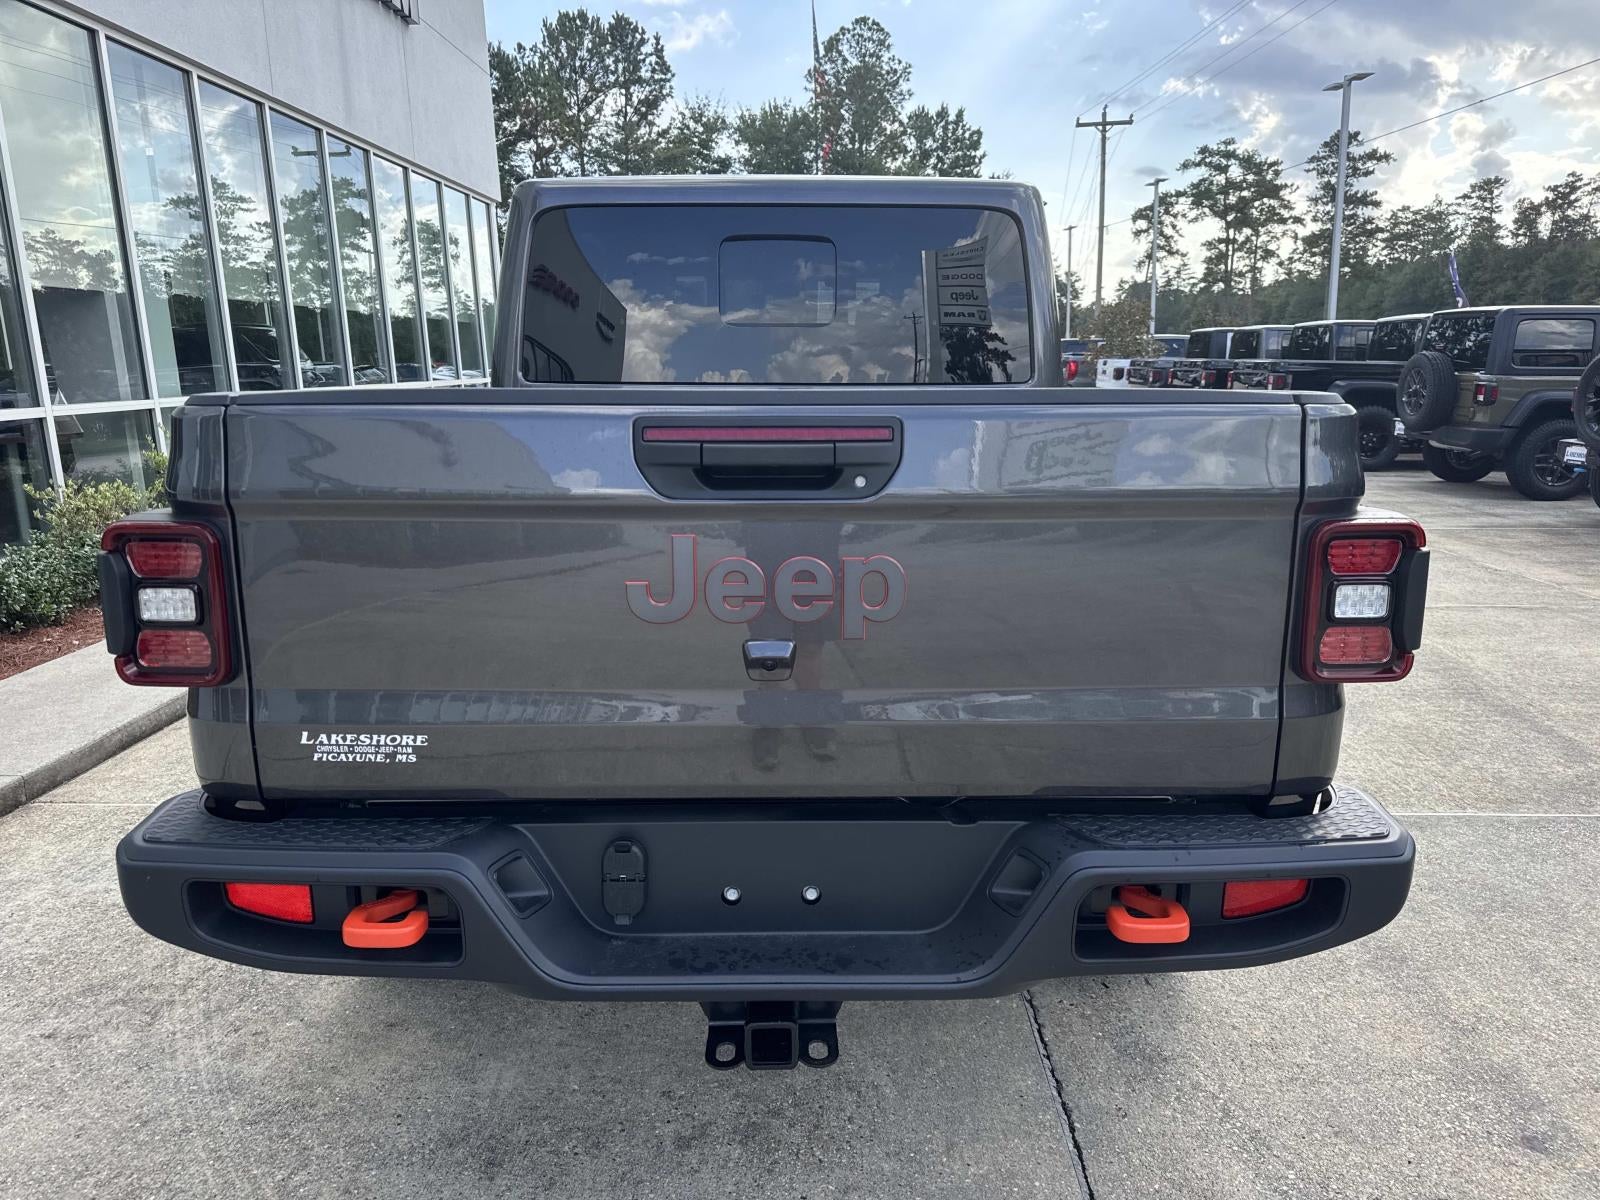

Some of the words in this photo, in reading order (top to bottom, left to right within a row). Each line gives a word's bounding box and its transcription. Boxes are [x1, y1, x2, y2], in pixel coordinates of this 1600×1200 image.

[625, 533, 908, 640] Jeep
[300, 731, 429, 746] LAKESHORE
[312, 753, 390, 763] PICAYUNE,
[395, 754, 417, 763] MS
